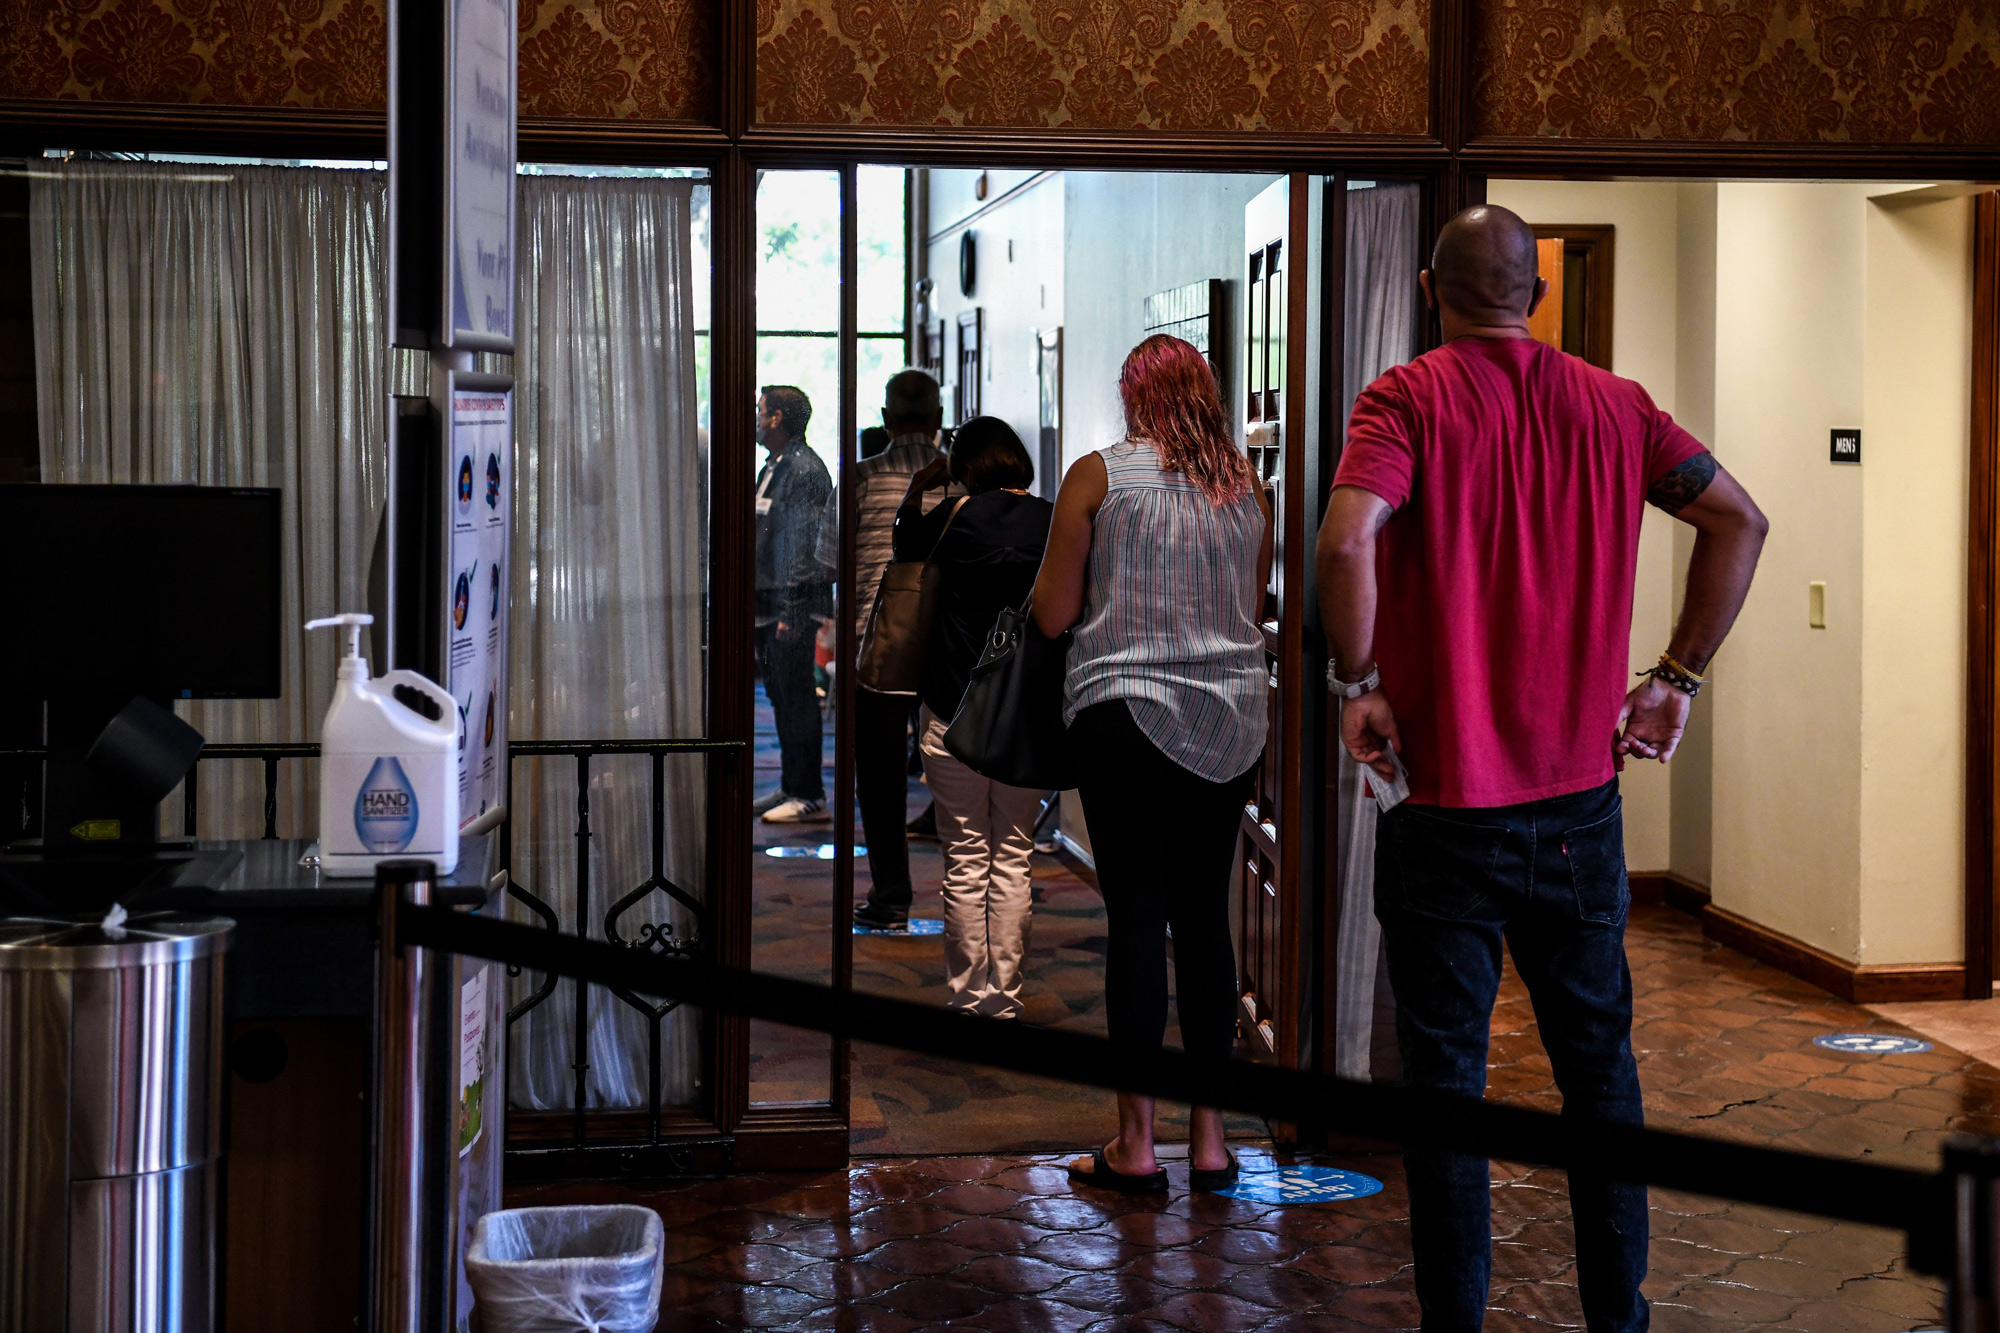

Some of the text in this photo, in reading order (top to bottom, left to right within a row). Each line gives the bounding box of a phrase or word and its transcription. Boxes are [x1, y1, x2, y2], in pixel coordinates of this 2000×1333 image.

[363, 793, 409, 806] HAND
[362, 807, 409, 815] SANITIZER
[1281, 1183, 1356, 1199] APART
